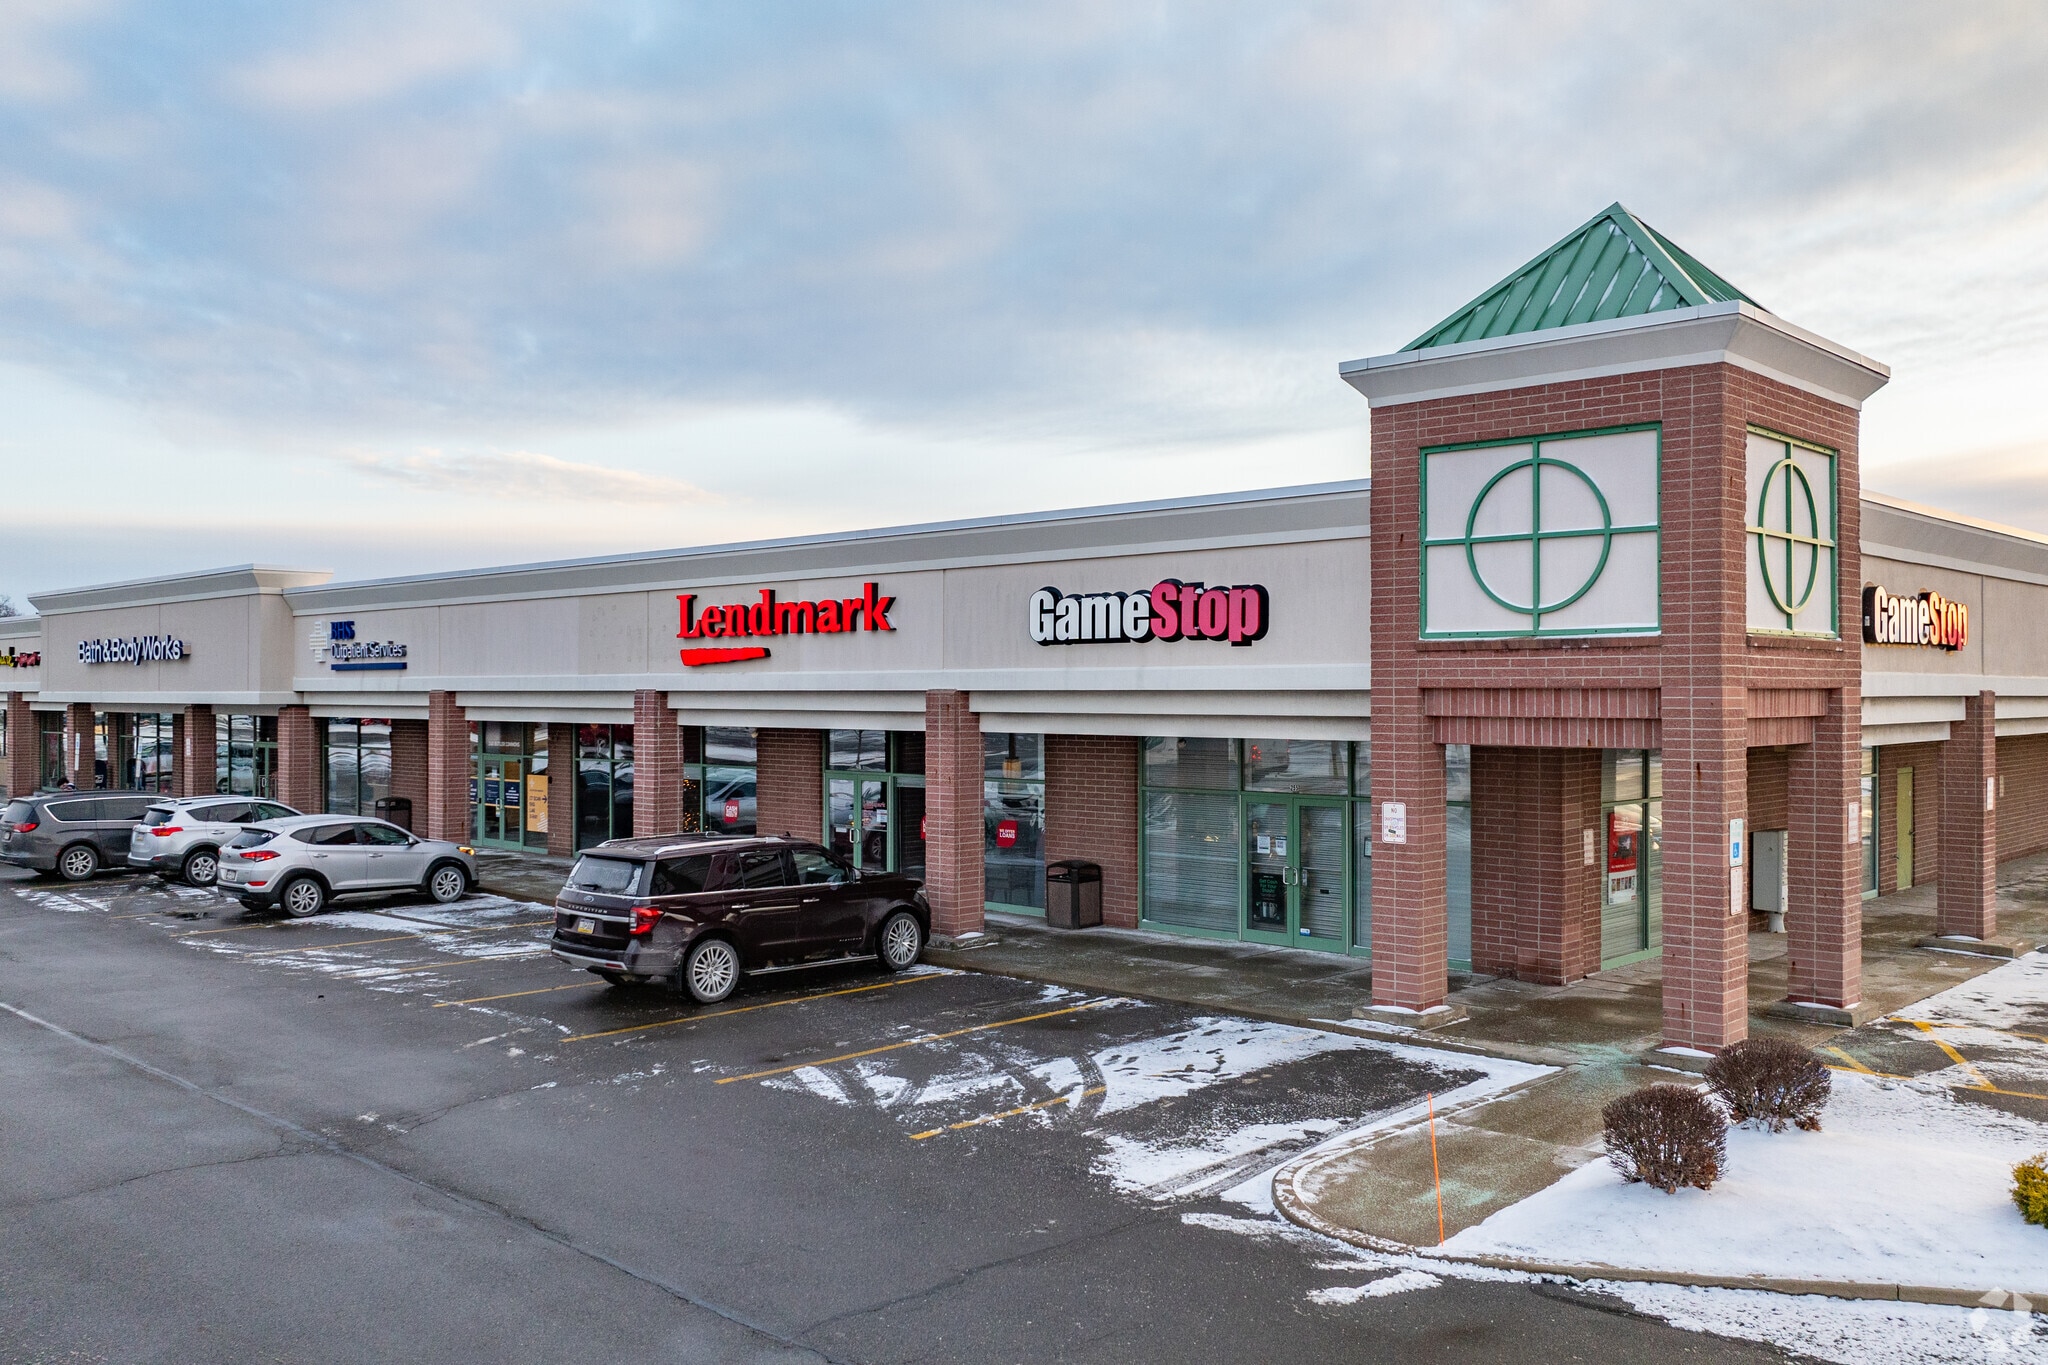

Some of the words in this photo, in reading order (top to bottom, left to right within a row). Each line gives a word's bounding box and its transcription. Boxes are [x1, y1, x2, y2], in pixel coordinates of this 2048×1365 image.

[676, 582, 895, 639] Lendmark
[1029, 580, 1266, 645] GameStop
[1873, 585, 1968, 651] GameStop
[331, 621, 355, 640] BHS
[142, 635, 183, 661] Works
[331, 643, 368, 661] Outpatient
[369, 641, 405, 657] Services
[567, 904, 608, 914] EXPEDITION
